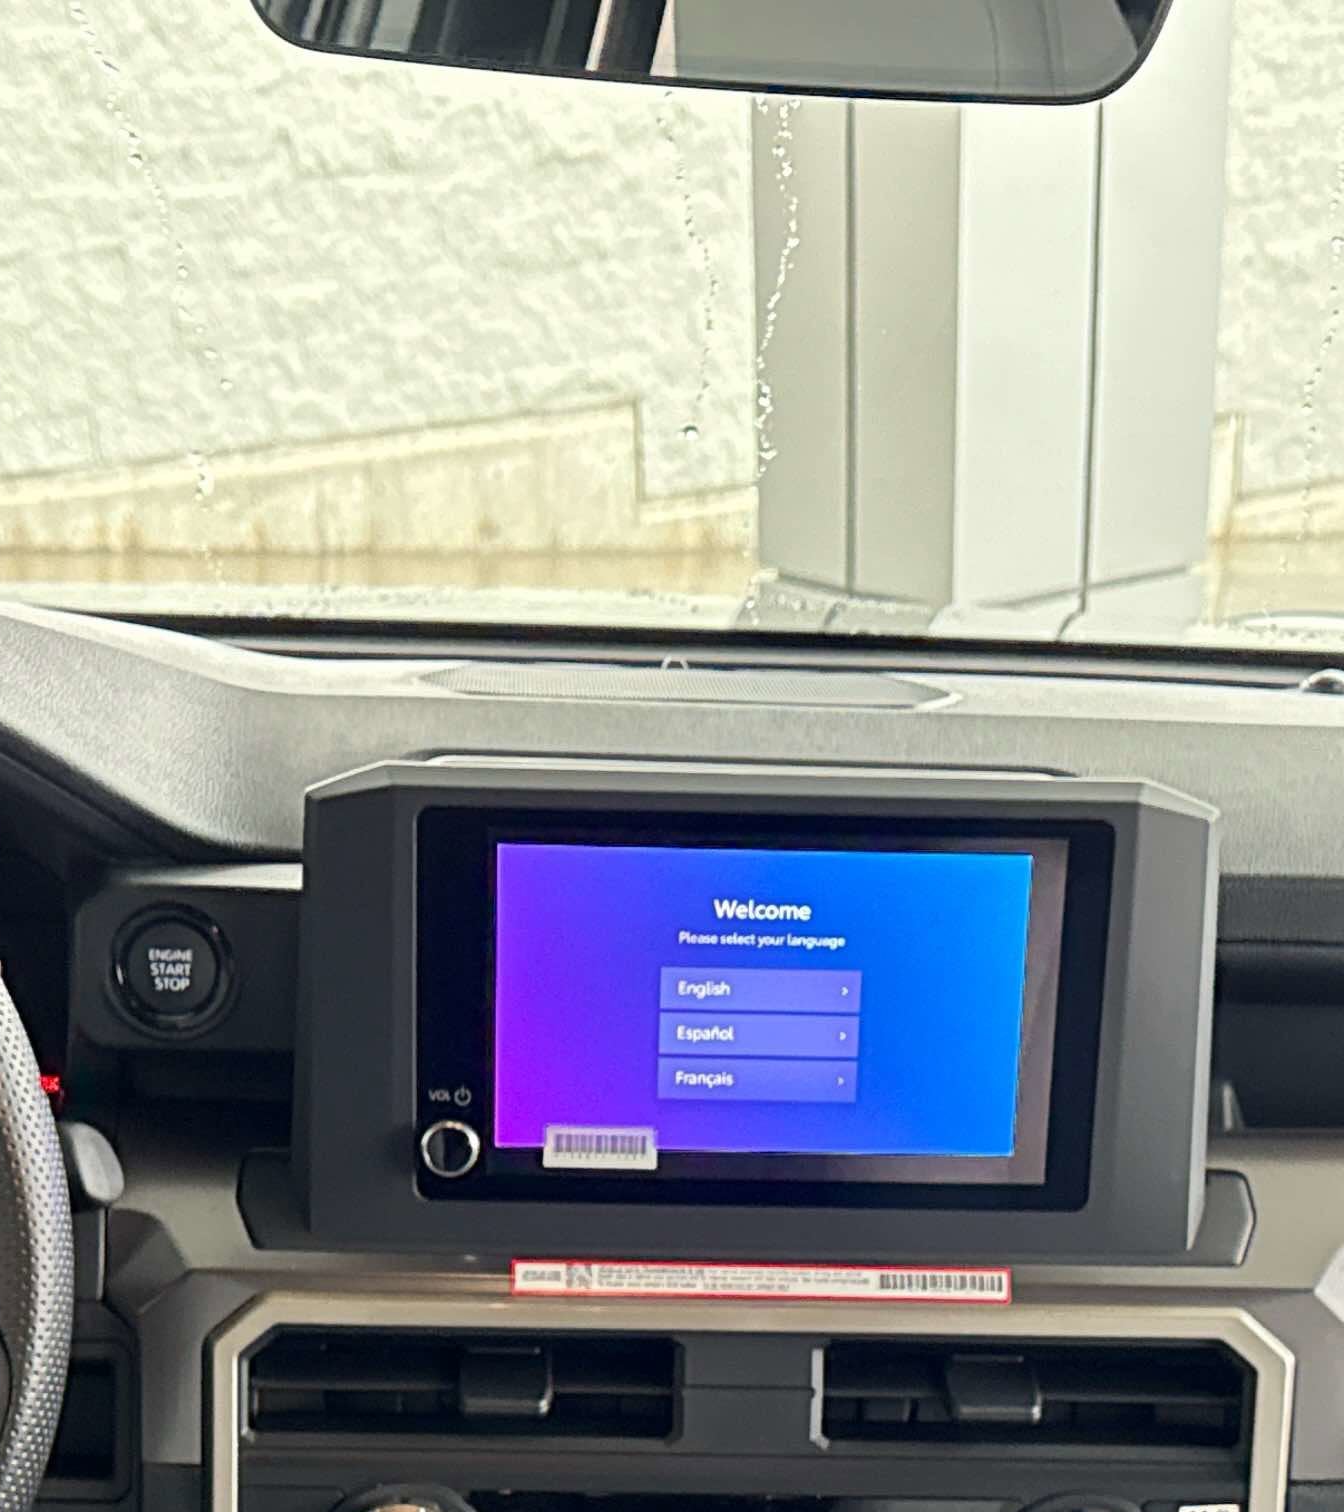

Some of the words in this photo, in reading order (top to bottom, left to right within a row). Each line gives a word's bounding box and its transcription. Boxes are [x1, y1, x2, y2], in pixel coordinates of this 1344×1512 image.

[713, 899, 812, 921] Welcome
[678, 931, 719, 945] Please
[720, 931, 756, 945] select
[757, 934, 786, 948] your
[787, 933, 846, 950] language
[148, 949, 193, 962] ENGINE
[150, 963, 191, 977] START
[154, 977, 191, 991] STOP
[678, 981, 731, 999] English
[676, 1025, 734, 1043] Español
[675, 1071, 734, 1088] Français
[428, 1088, 451, 1101] VOL
